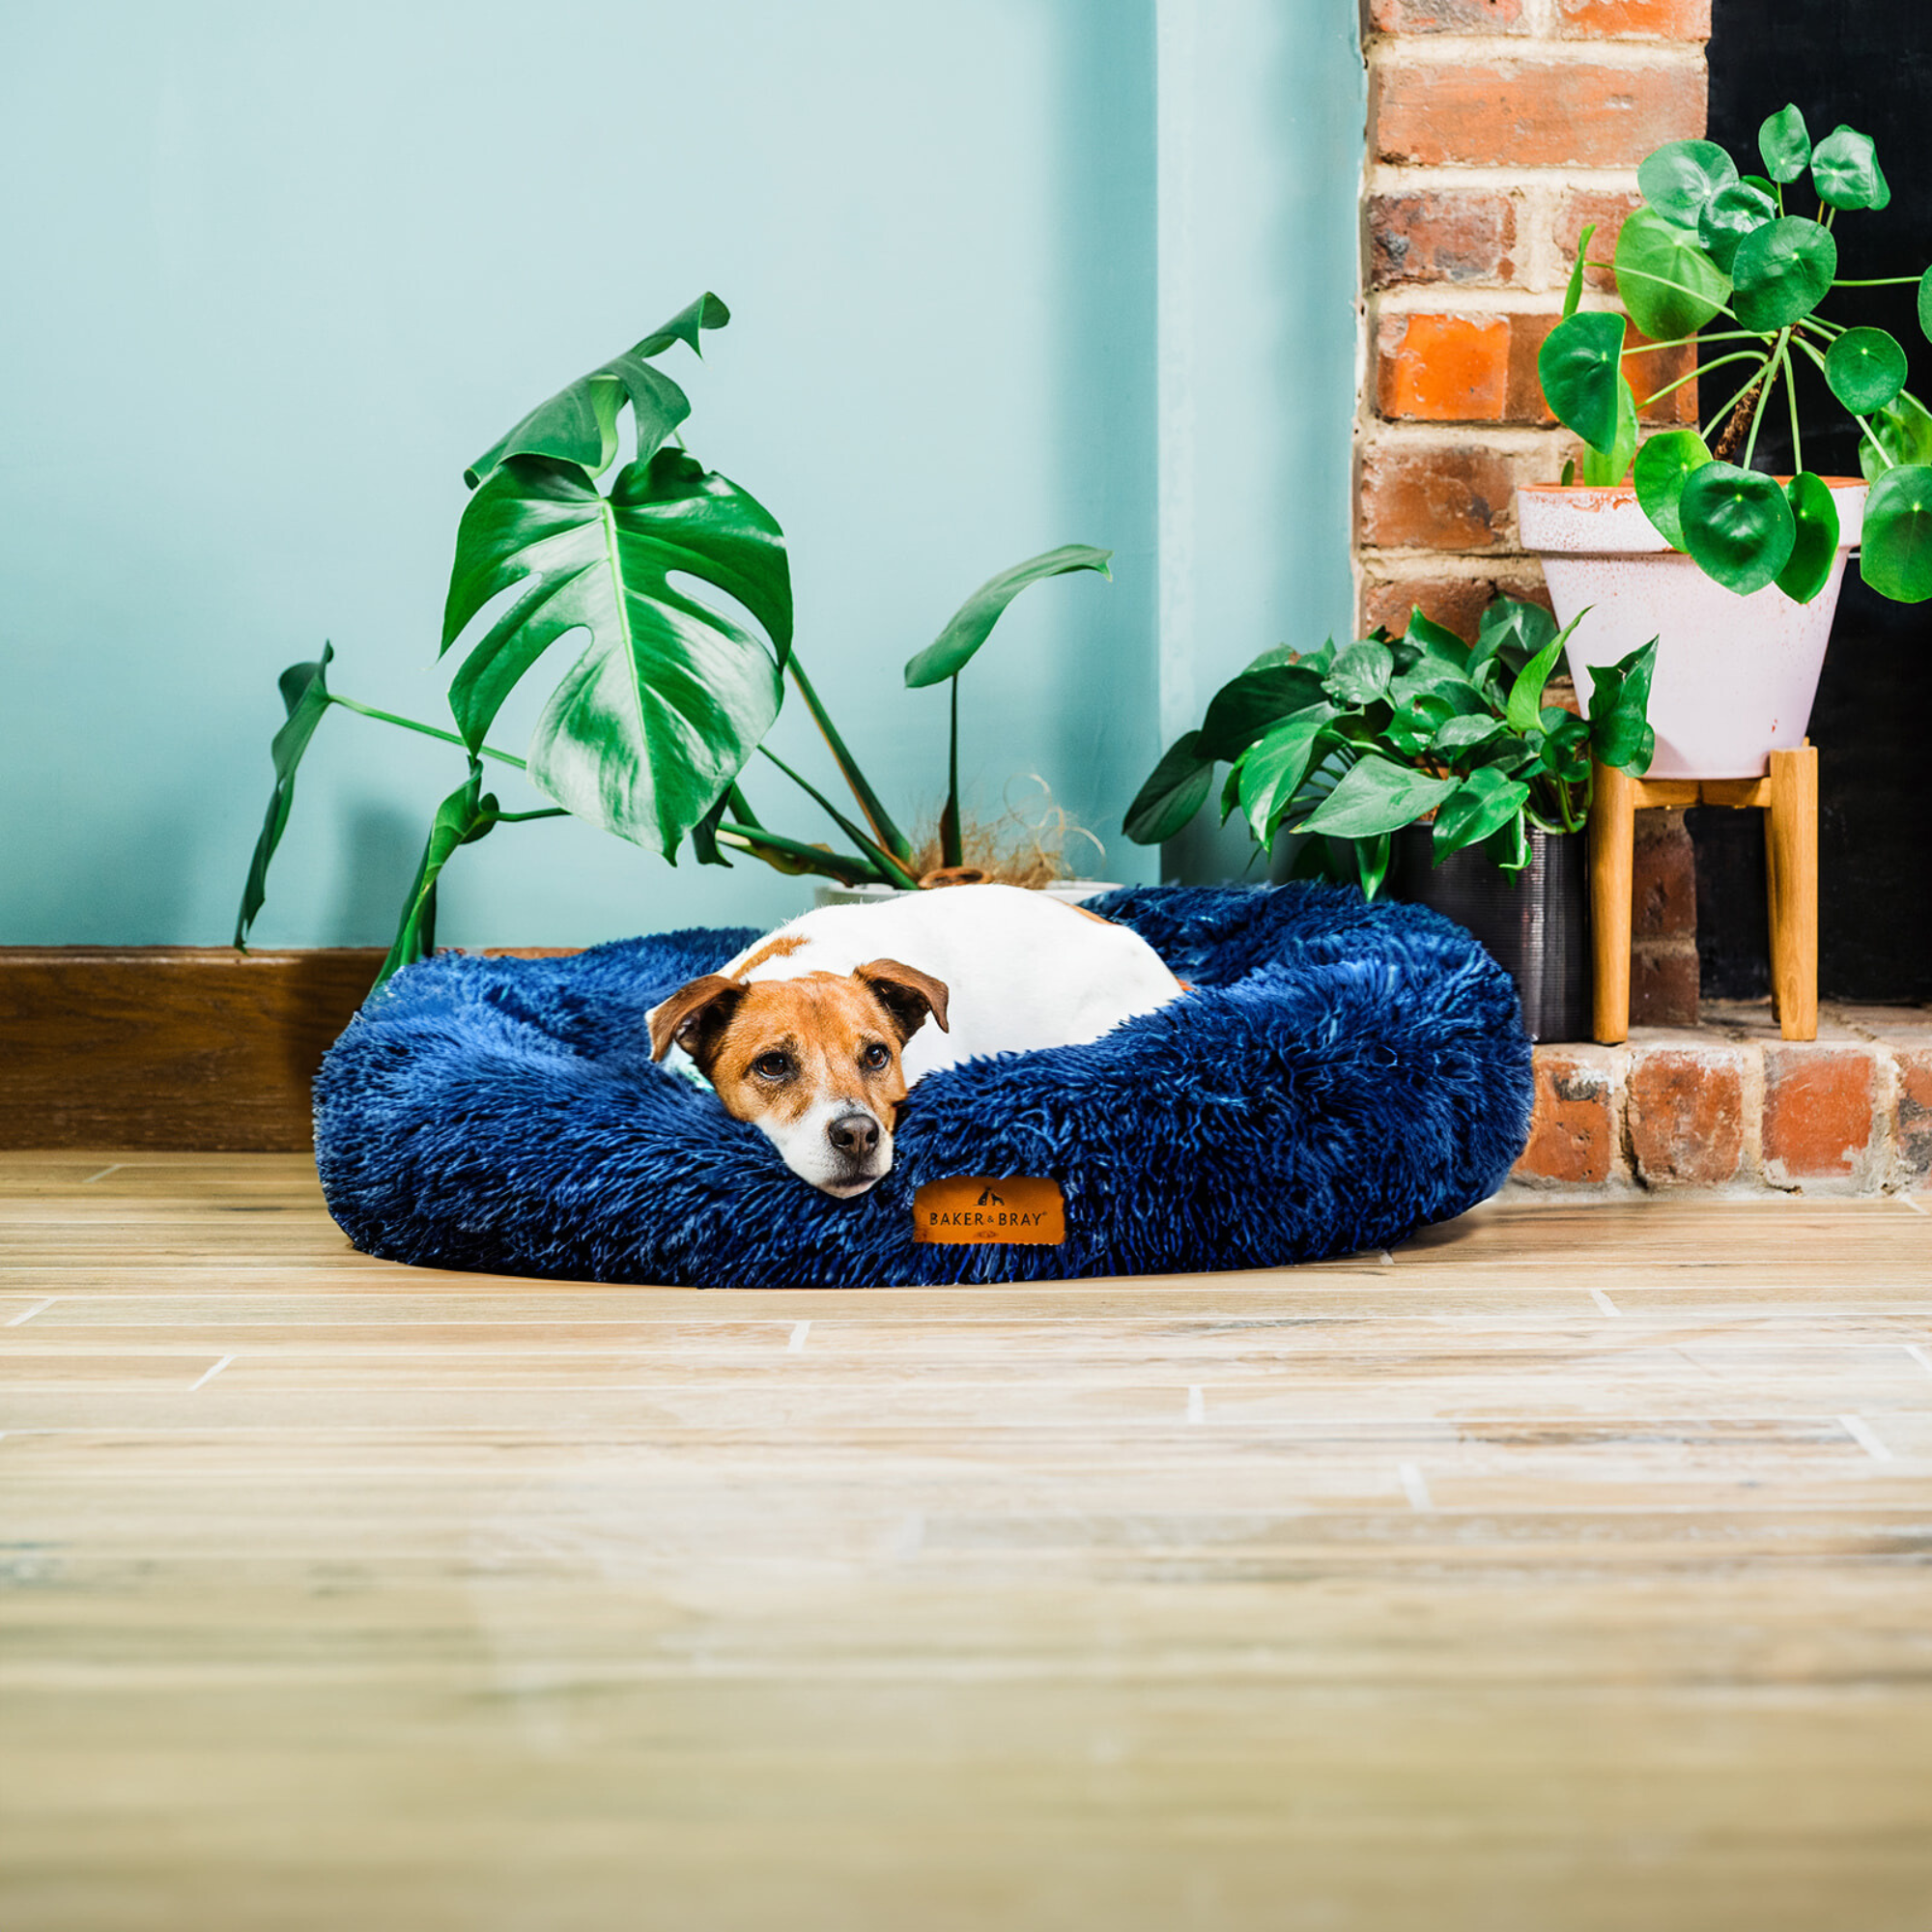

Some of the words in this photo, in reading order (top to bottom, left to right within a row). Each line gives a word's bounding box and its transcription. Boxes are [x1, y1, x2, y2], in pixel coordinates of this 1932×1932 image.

[929, 1212, 983, 1226] BAKER
[987, 1215, 995, 1224] &
[998, 1212, 1042, 1226] BRAY
